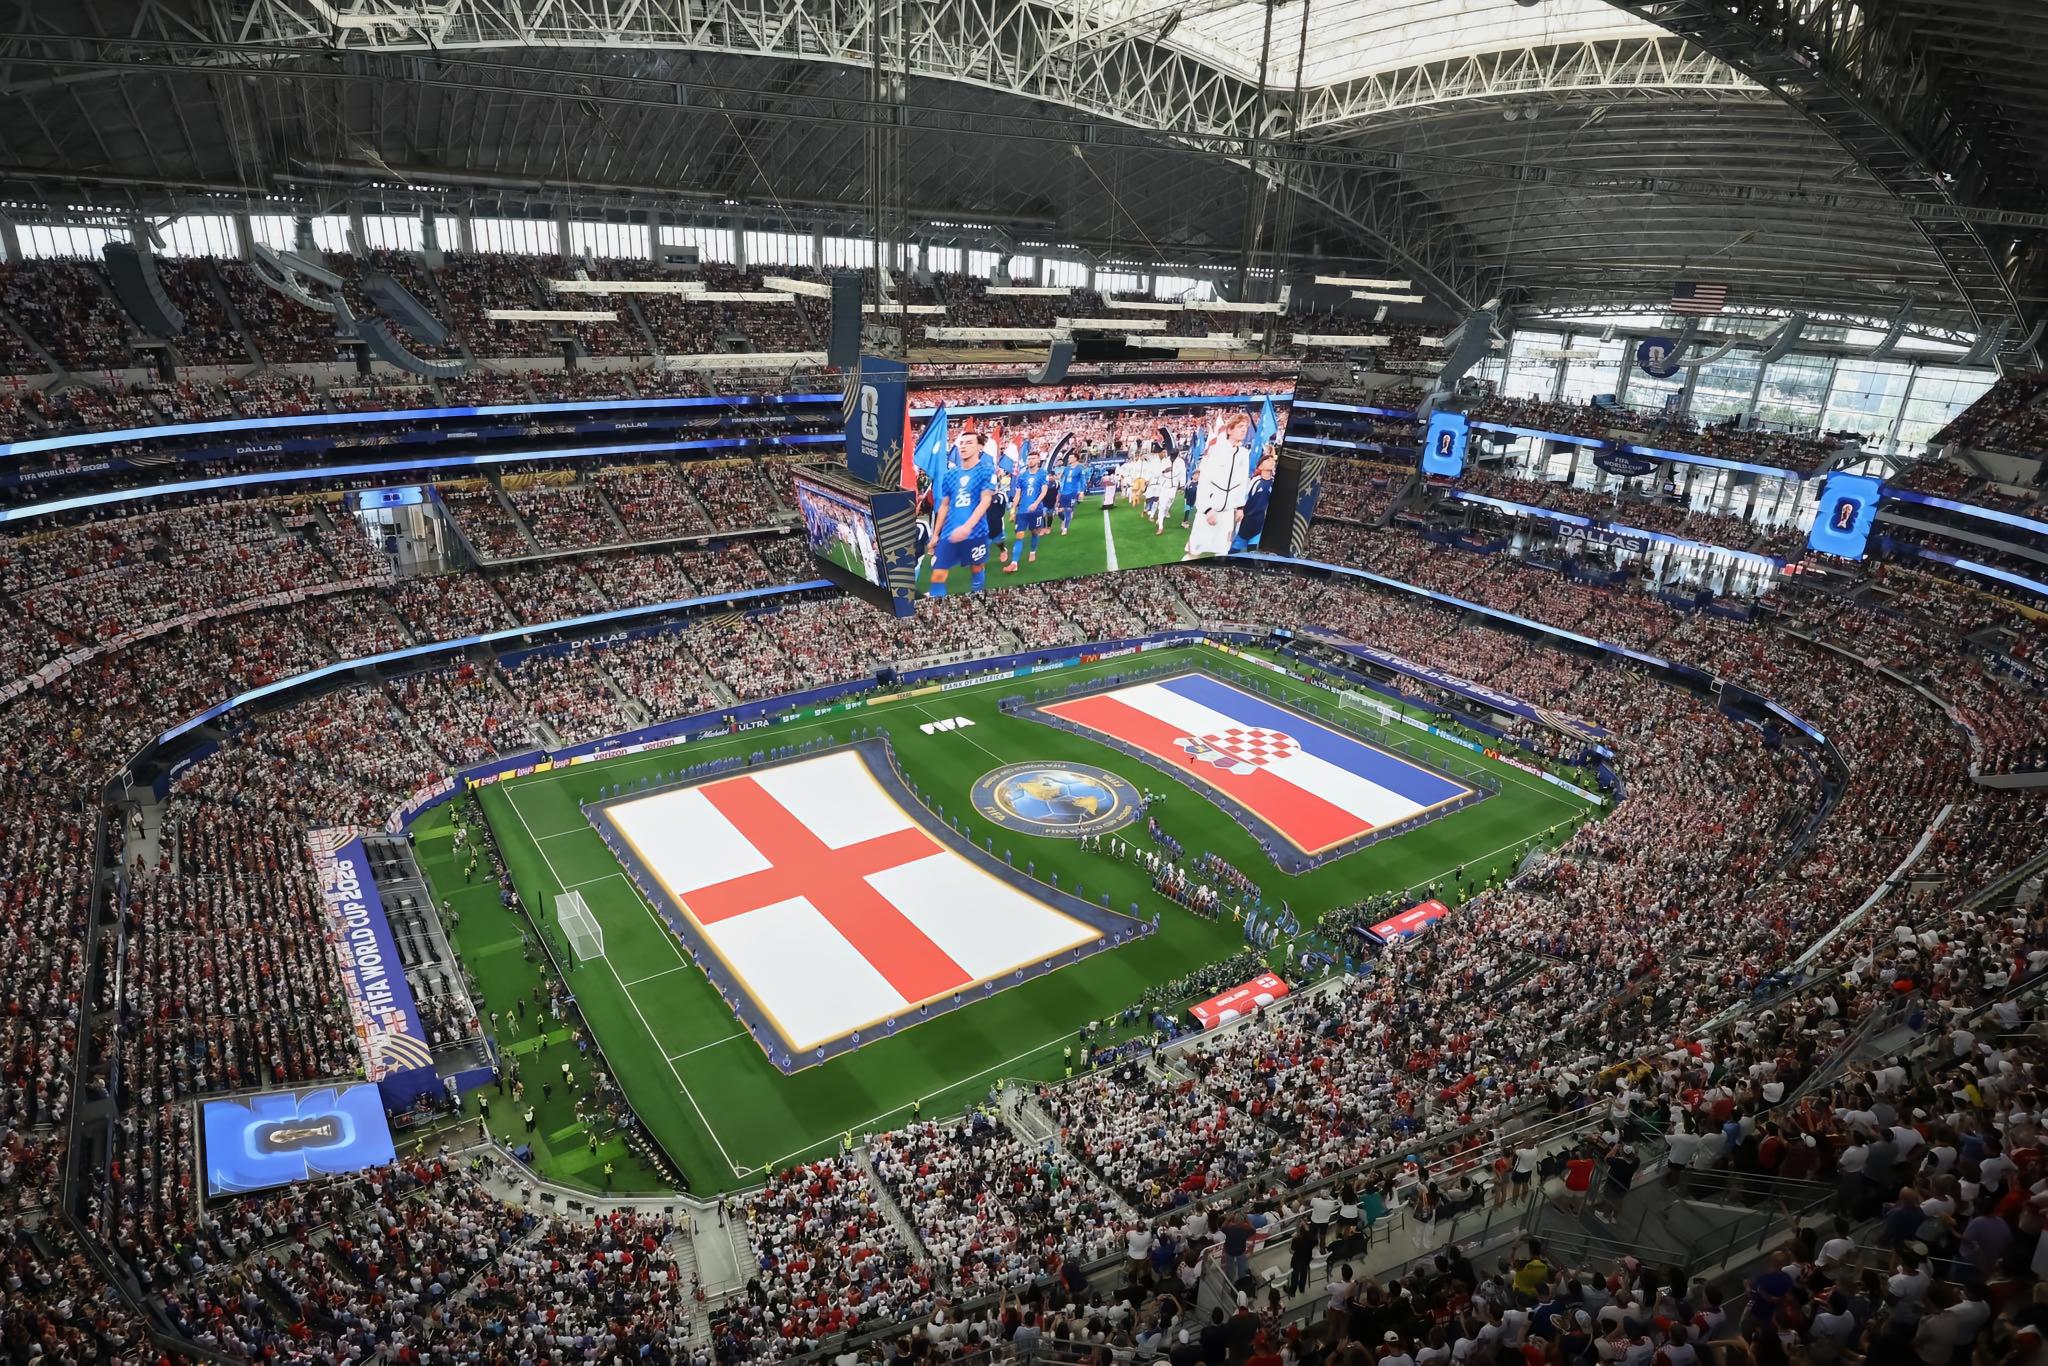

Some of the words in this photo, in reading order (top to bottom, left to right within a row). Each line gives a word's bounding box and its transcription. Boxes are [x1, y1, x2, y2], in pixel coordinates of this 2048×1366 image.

[615, 421, 648, 429] DALLAS
[236, 444, 283, 454] DALLAS
[1603, 460, 1629, 469] WORLD
[1615, 457, 1629, 465] FIFA
[19, 472, 37, 482] FIFA
[37, 468, 65, 480] WORLD
[81, 463, 110, 472] 2026
[955, 493, 972, 508] 26
[1558, 524, 1641, 552] DALLAS
[971, 544, 987, 561] 26
[571, 632, 628, 650] DALLAS
[1031, 662, 1064, 674] Hisense
[1363, 648, 1393, 662] FIFA
[1391, 658, 1440, 679] WORLD
[1437, 675, 1468, 688] CUP
[738, 719, 770, 731] ULTRA
[642, 738, 675, 751] verizon
[1434, 728, 1475, 749] Hisense
[593, 748, 628, 761] verizon
[1498, 754, 1542, 777] McDonald's
[983, 805, 1006, 821] FIFA
[336, 859, 363, 901] 2026
[343, 902, 371, 928] CUP
[351, 927, 386, 982] WORLD
[364, 978, 397, 1016] FIFA
